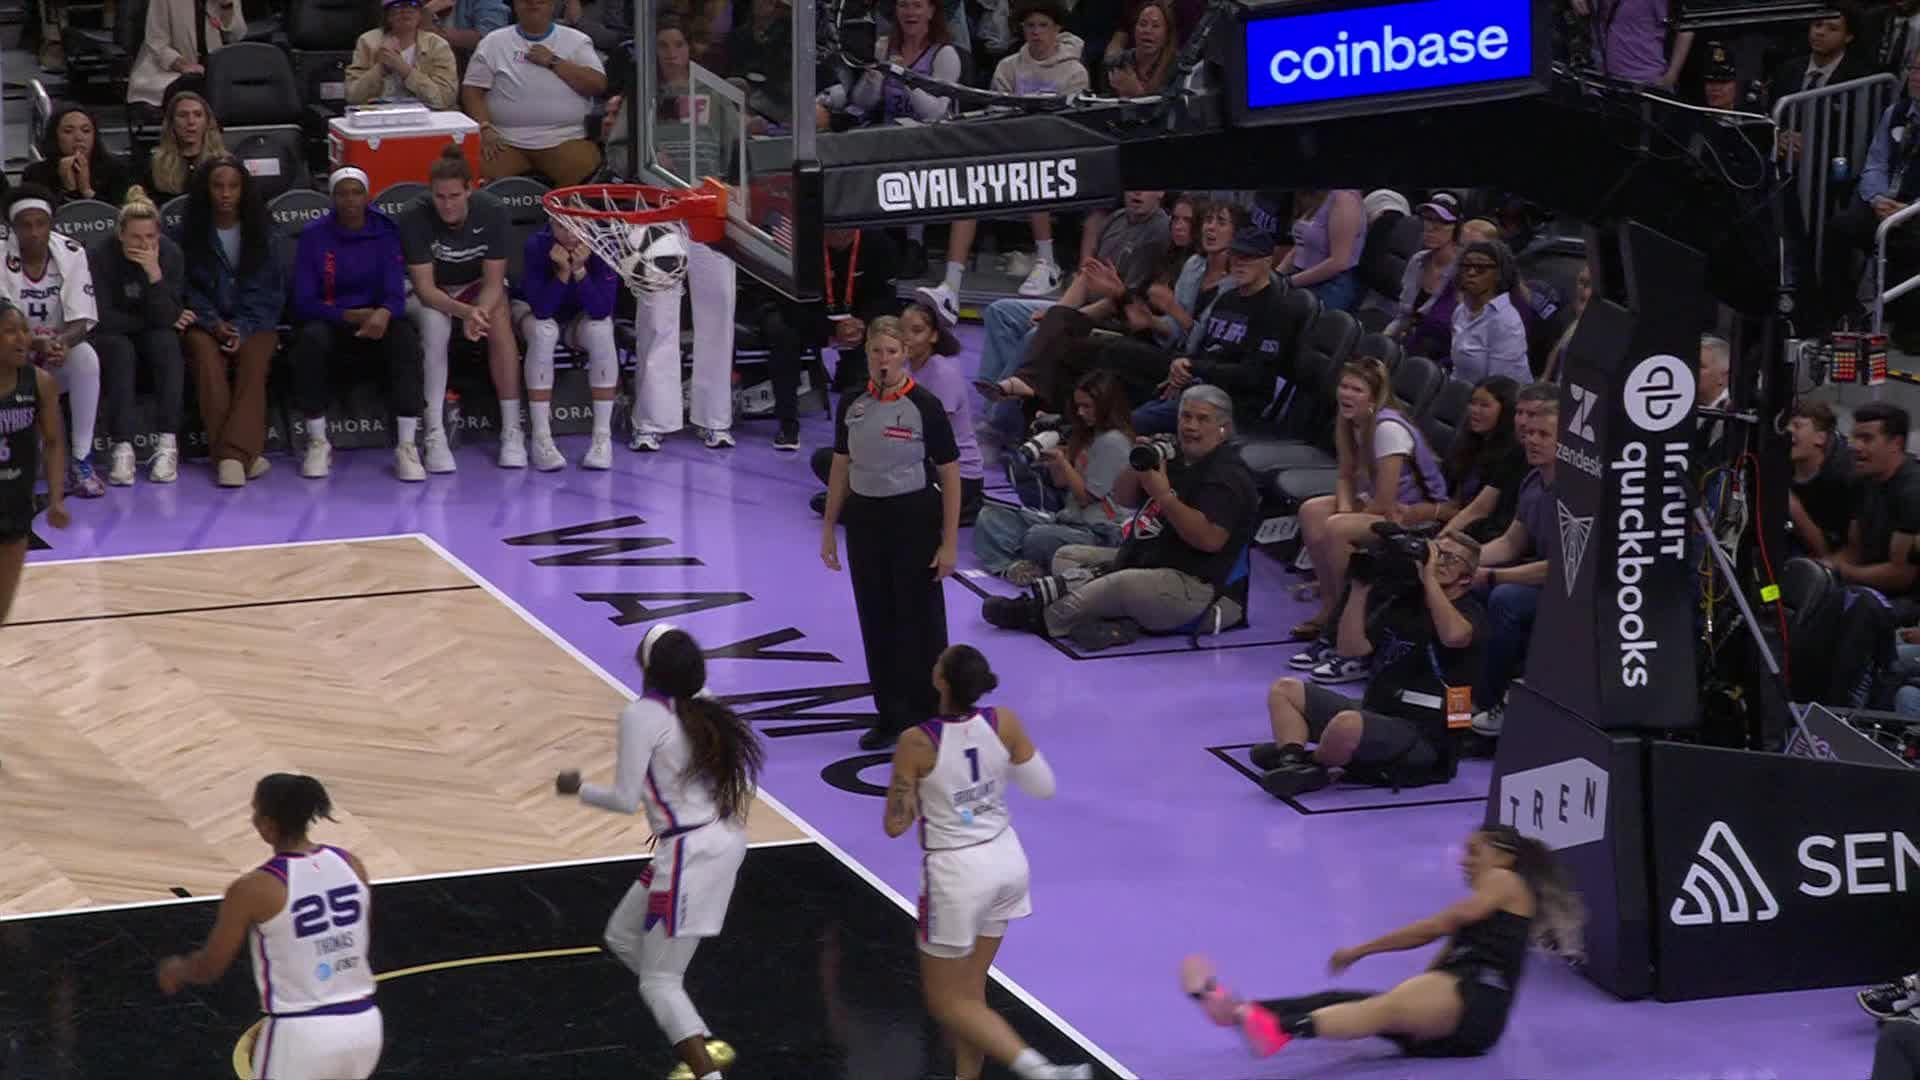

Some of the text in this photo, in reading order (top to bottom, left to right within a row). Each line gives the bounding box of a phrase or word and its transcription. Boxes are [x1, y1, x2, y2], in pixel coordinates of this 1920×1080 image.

[1269, 24, 1509, 84] coinbase
[876, 158, 1077, 212] @VALKYRIES
[55, 219, 114, 234] SEPHOR
[272, 208, 330, 222] SEPHOR
[28, 302, 48, 321] 4
[295, 419, 384, 434] SHORA
[1556, 441, 1602, 479] zendesk
[1611, 441, 1658, 687] quickbooks
[964, 747, 980, 782] 1
[1509, 777, 1597, 832] TREN
[290, 884, 362, 939] 25
